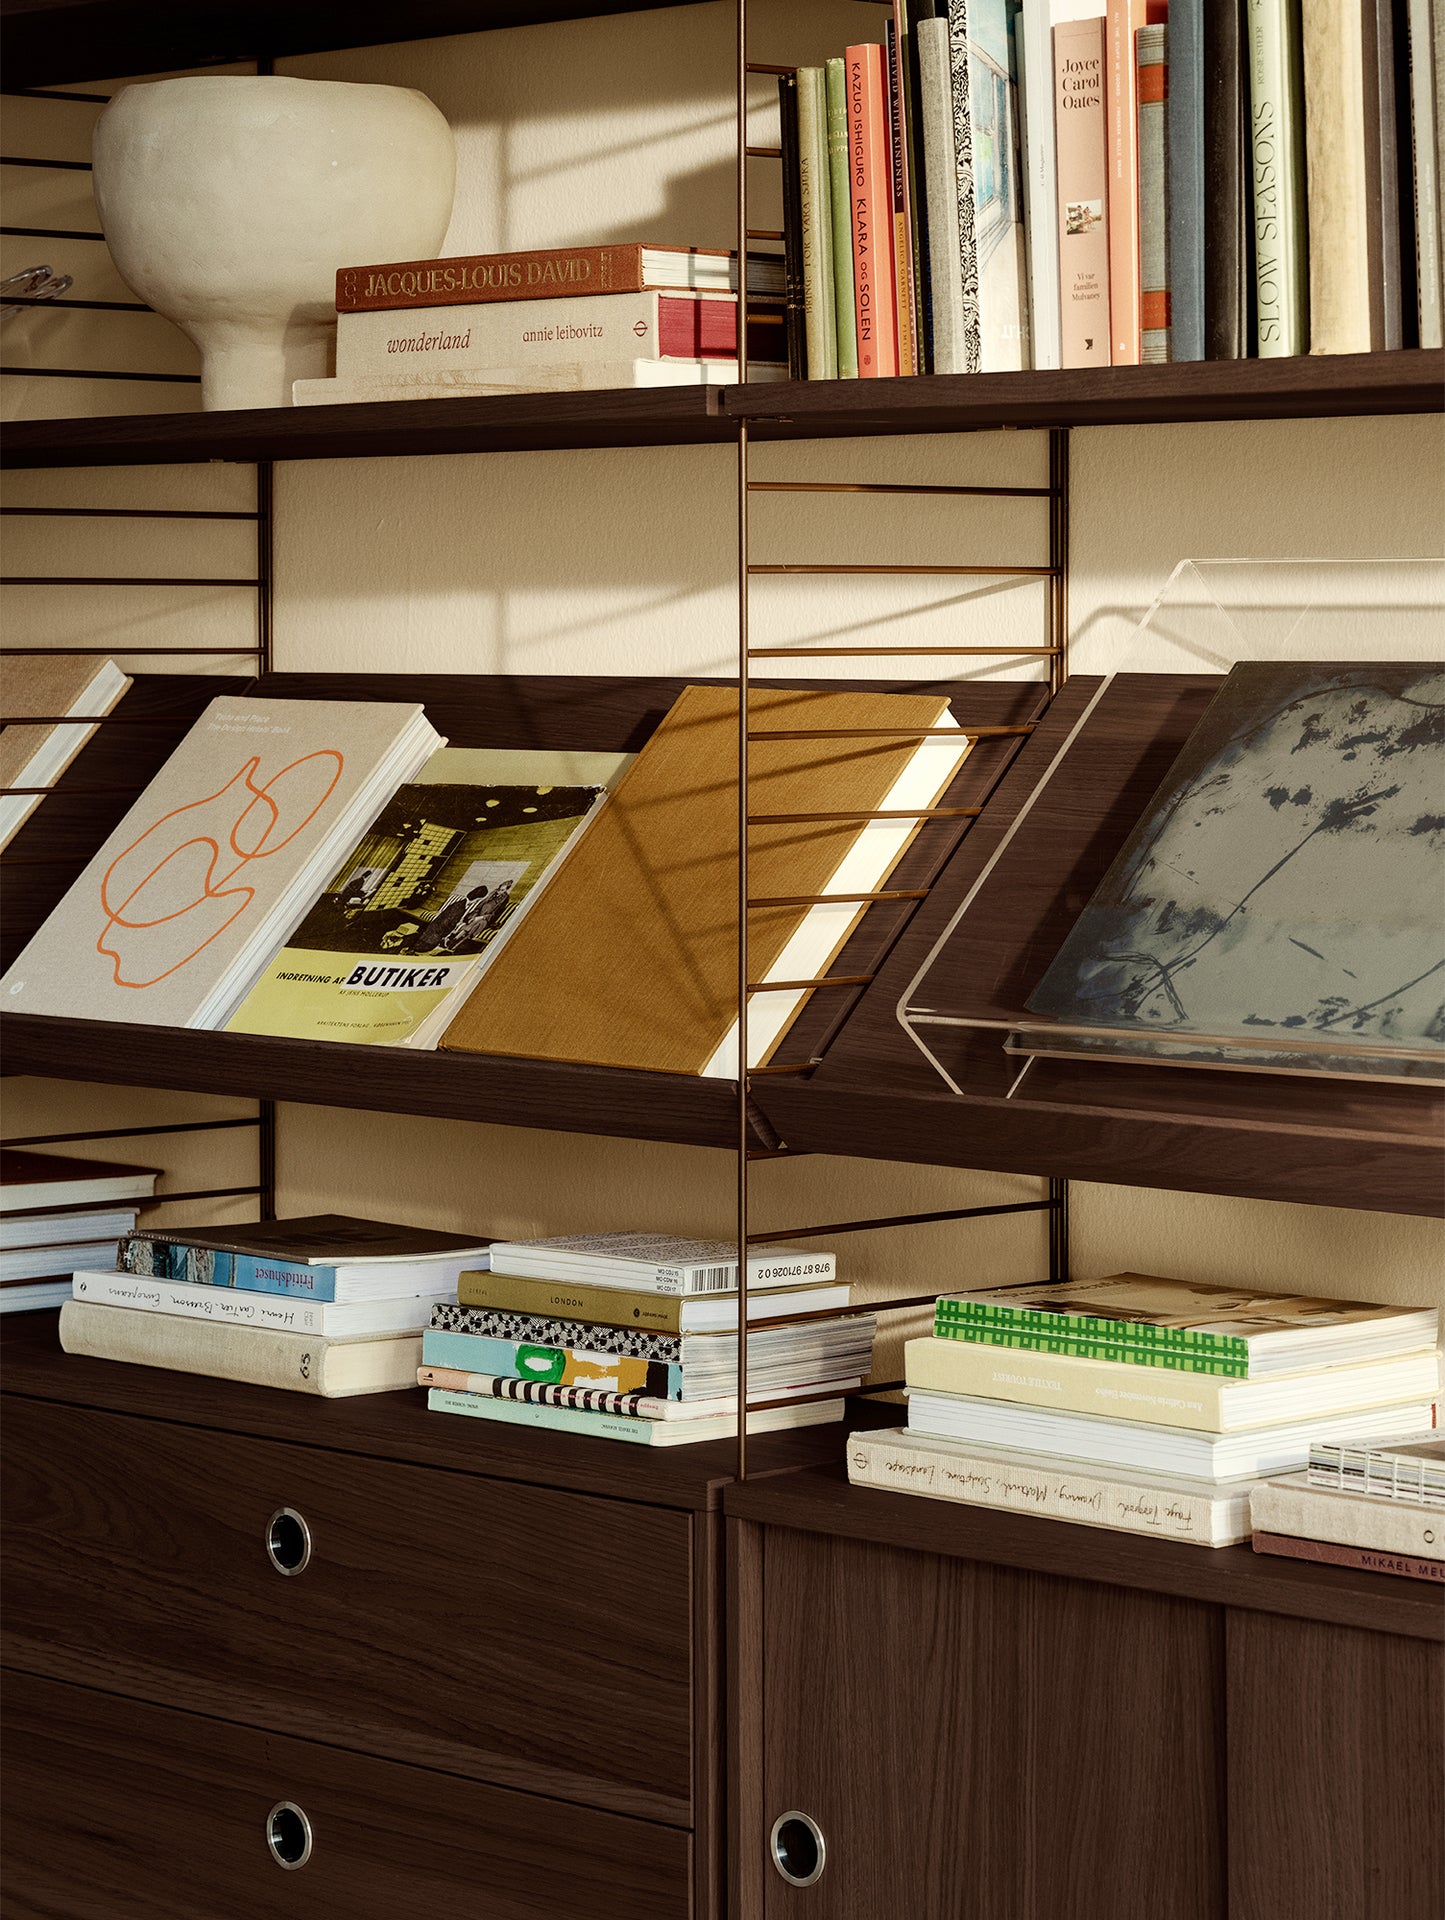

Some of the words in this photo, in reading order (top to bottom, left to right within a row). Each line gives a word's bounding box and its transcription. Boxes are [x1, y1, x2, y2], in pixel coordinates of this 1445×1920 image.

[1062, 59, 1100, 74] Joyce
[852, 62, 862, 114] KAZUO
[1062, 74, 1100, 92] Carol
[1062, 95, 1100, 110] Oates
[854, 120, 865, 187] ISHIGURO
[894, 136, 903, 198] KINDNESS
[1254, 100, 1278, 241] SEASONS
[857, 198, 868, 256] KLARA
[364, 263, 522, 297] JACQUES-LOUIS
[527, 258, 592, 284] DAVID
[860, 262, 868, 281] OG
[1258, 251, 1280, 342] SLOW
[860, 282, 871, 341] SOLEN
[386, 328, 472, 354] wonderland
[522, 326, 553, 342] annie
[556, 322, 603, 340] leibovitz
[276, 972, 331, 984] INDRETNING
[332, 976, 346, 984] AF
[346, 966, 450, 988] BUTIKER
[758, 1269, 764, 1280] 2
[765, 1268, 771, 1278] 0
[772, 1266, 802, 1278] 971026
[803, 1264, 814, 1274] 87
[814, 1262, 830, 1273] 978
[255, 1266, 314, 1290] Fritidshuset
[108, 1282, 162, 1308] Europeans
[550, 1296, 584, 1307] LONDON
[262, 1308, 294, 1325] Henri
[992, 1372, 1027, 1386] TOURIST
[1028, 1376, 1062, 1391] TEXTILE
[886, 1460, 934, 1484] Landscape
[1166, 1504, 1193, 1531] Faye
[1362, 1556, 1411, 1572] MIKAEL
